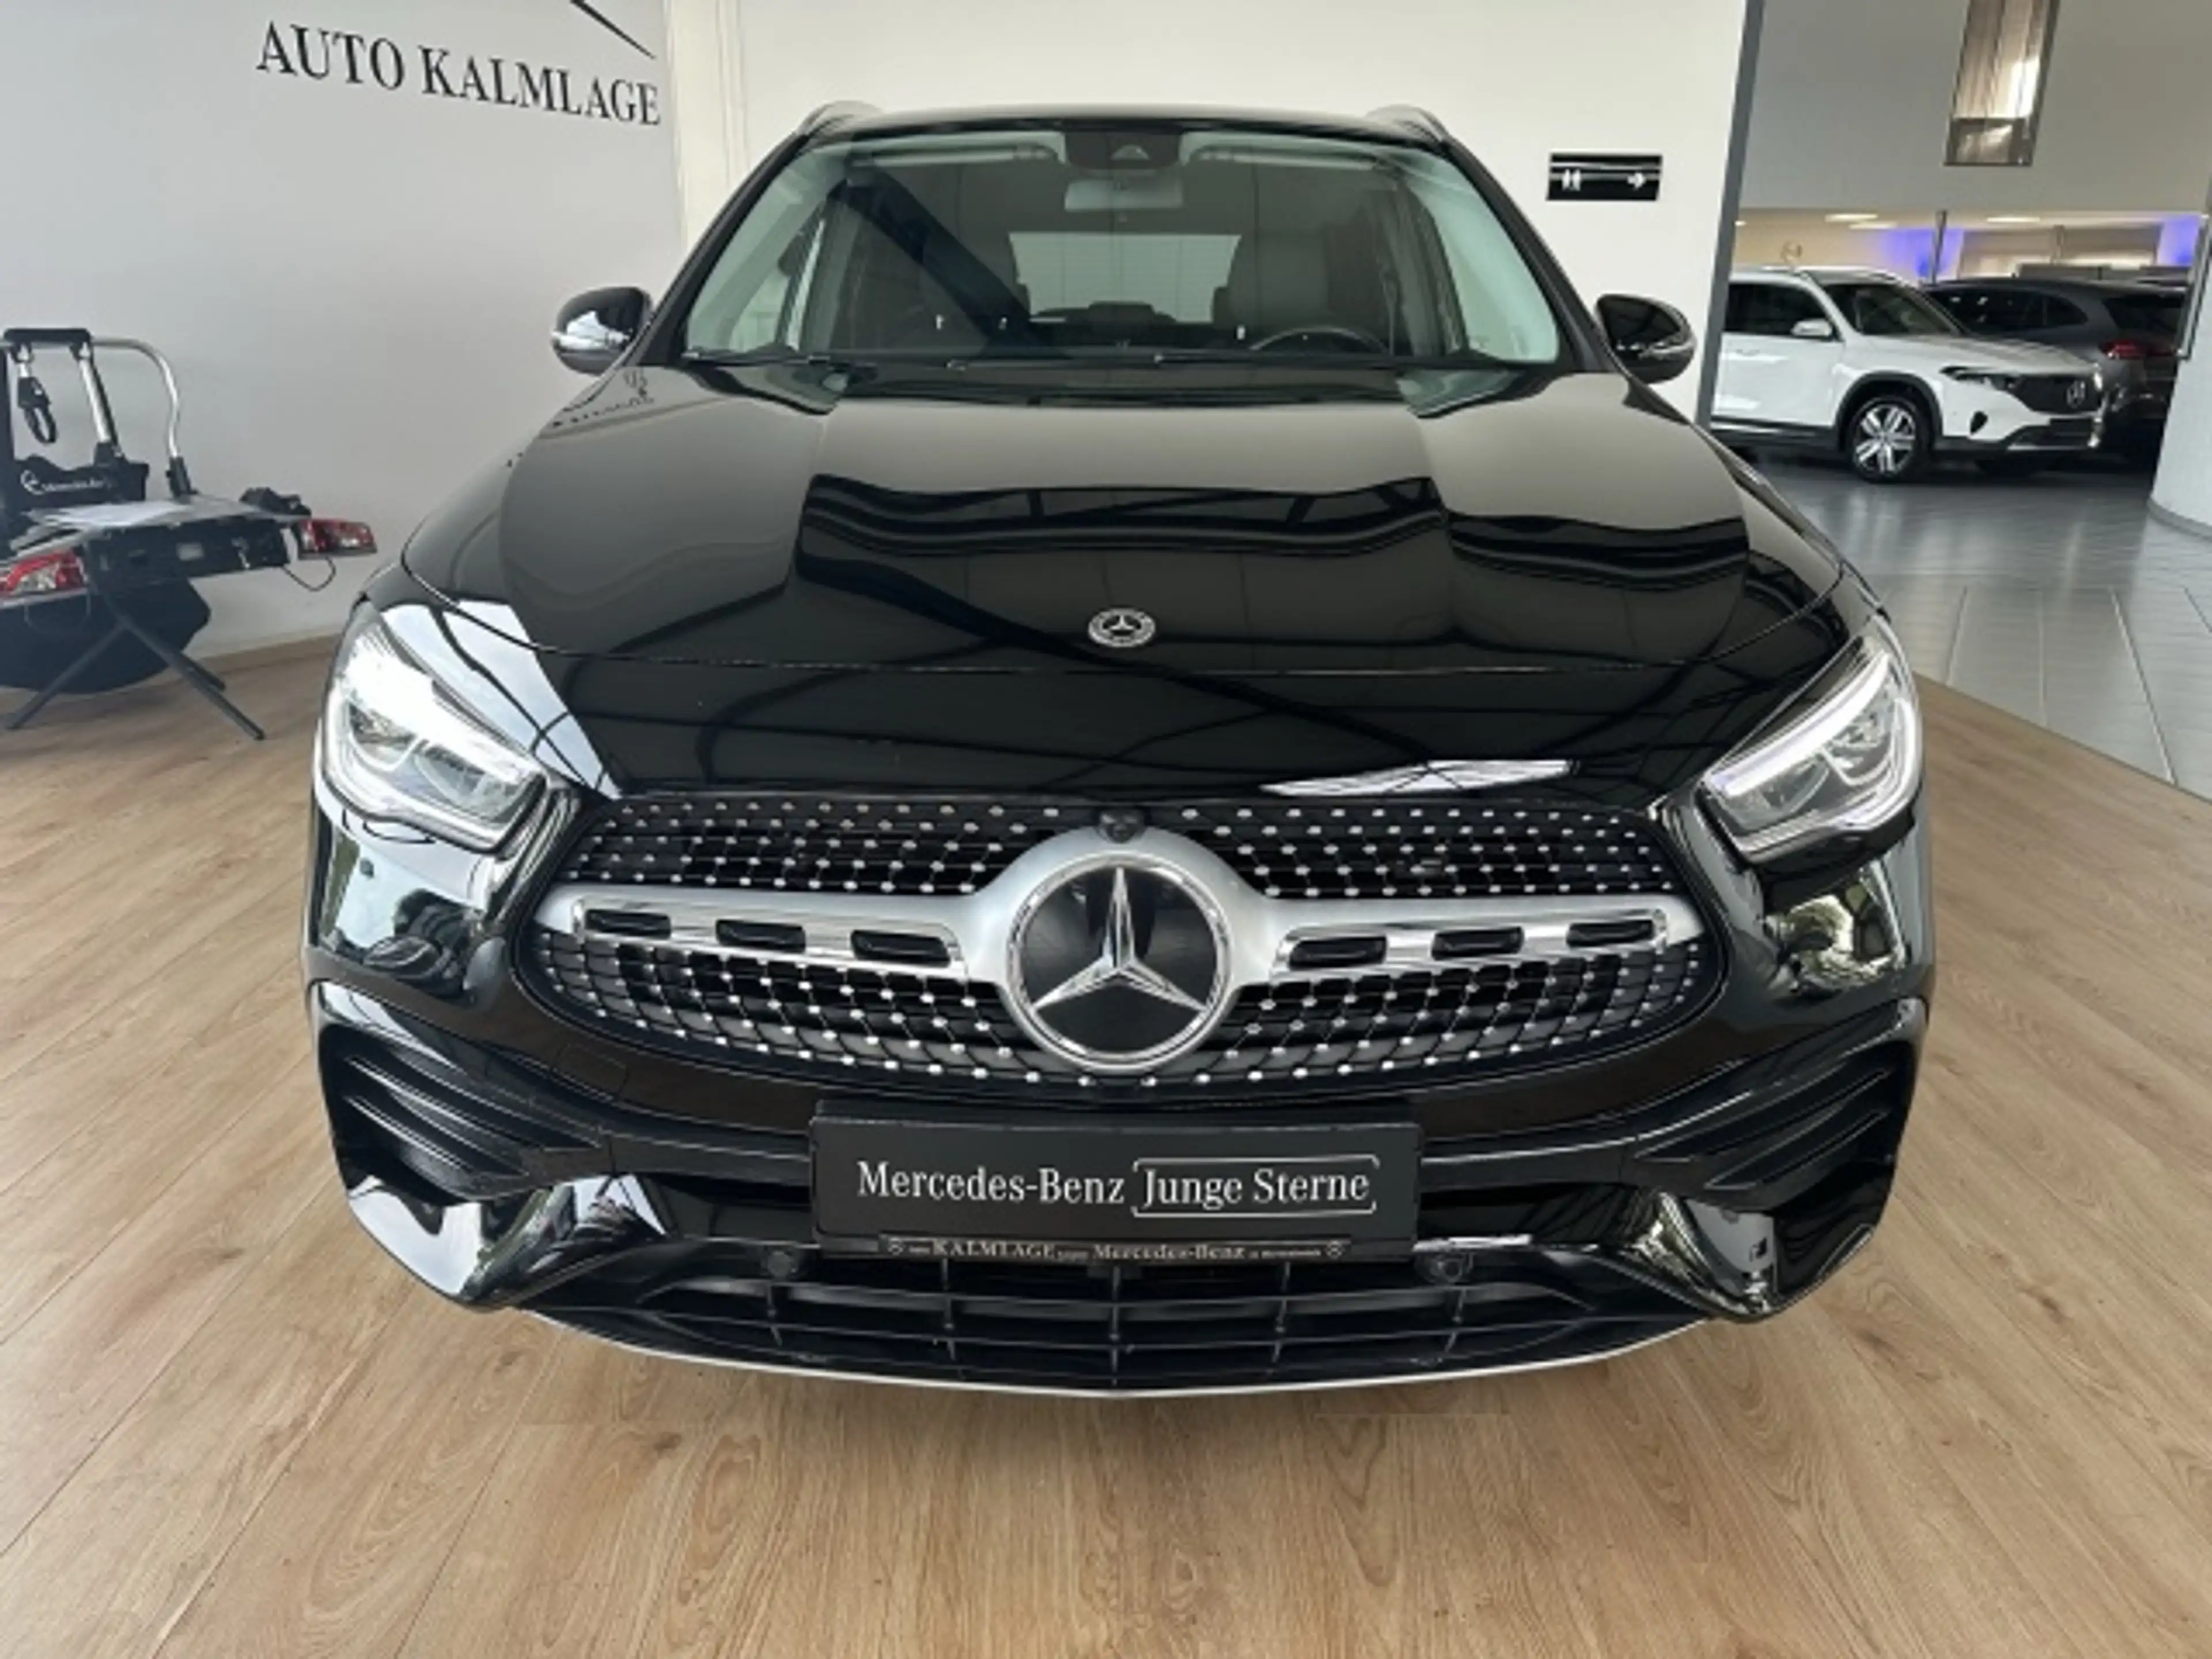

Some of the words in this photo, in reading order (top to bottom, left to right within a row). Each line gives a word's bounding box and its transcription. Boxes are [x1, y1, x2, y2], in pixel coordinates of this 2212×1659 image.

[256, 21, 404, 90] AUTO
[418, 45, 661, 126] KALMLAGE
[857, 1160, 1125, 1204] Mercedes-Benz
[1142, 1168, 1243, 1210] Junge
[1253, 1167, 1370, 1204] Sterne
